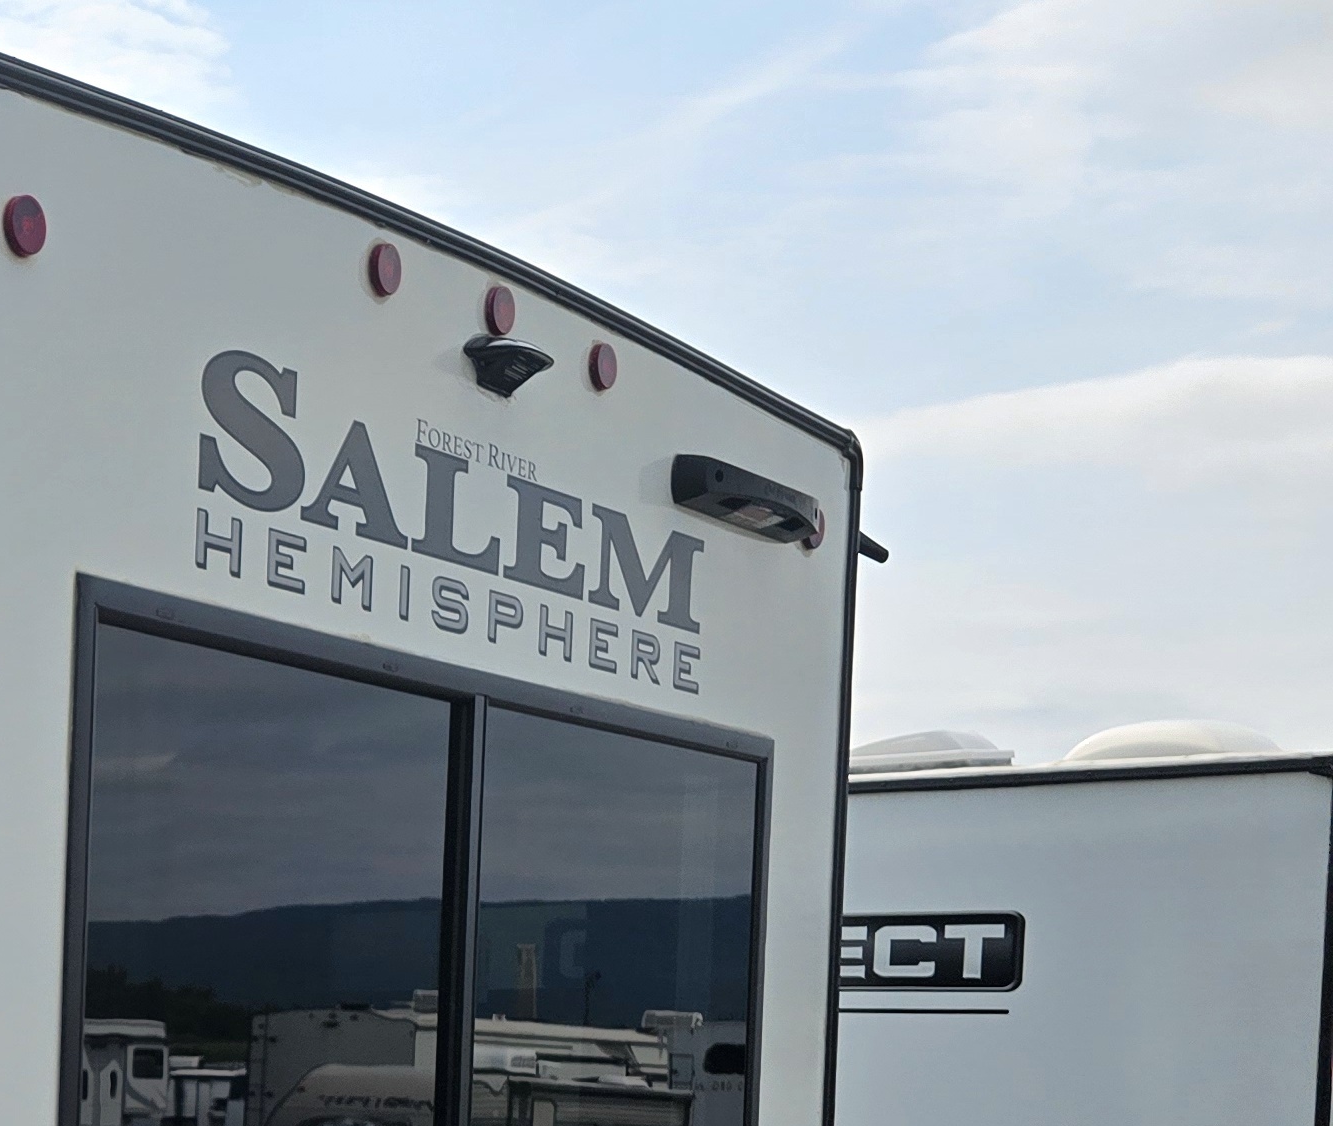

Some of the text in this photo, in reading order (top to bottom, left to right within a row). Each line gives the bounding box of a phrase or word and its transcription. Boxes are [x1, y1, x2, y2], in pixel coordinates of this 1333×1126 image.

[197, 349, 705, 634] SALEM
[415, 417, 538, 482] FOREST RIVER
[195, 507, 701, 695] HEMISPHERE
